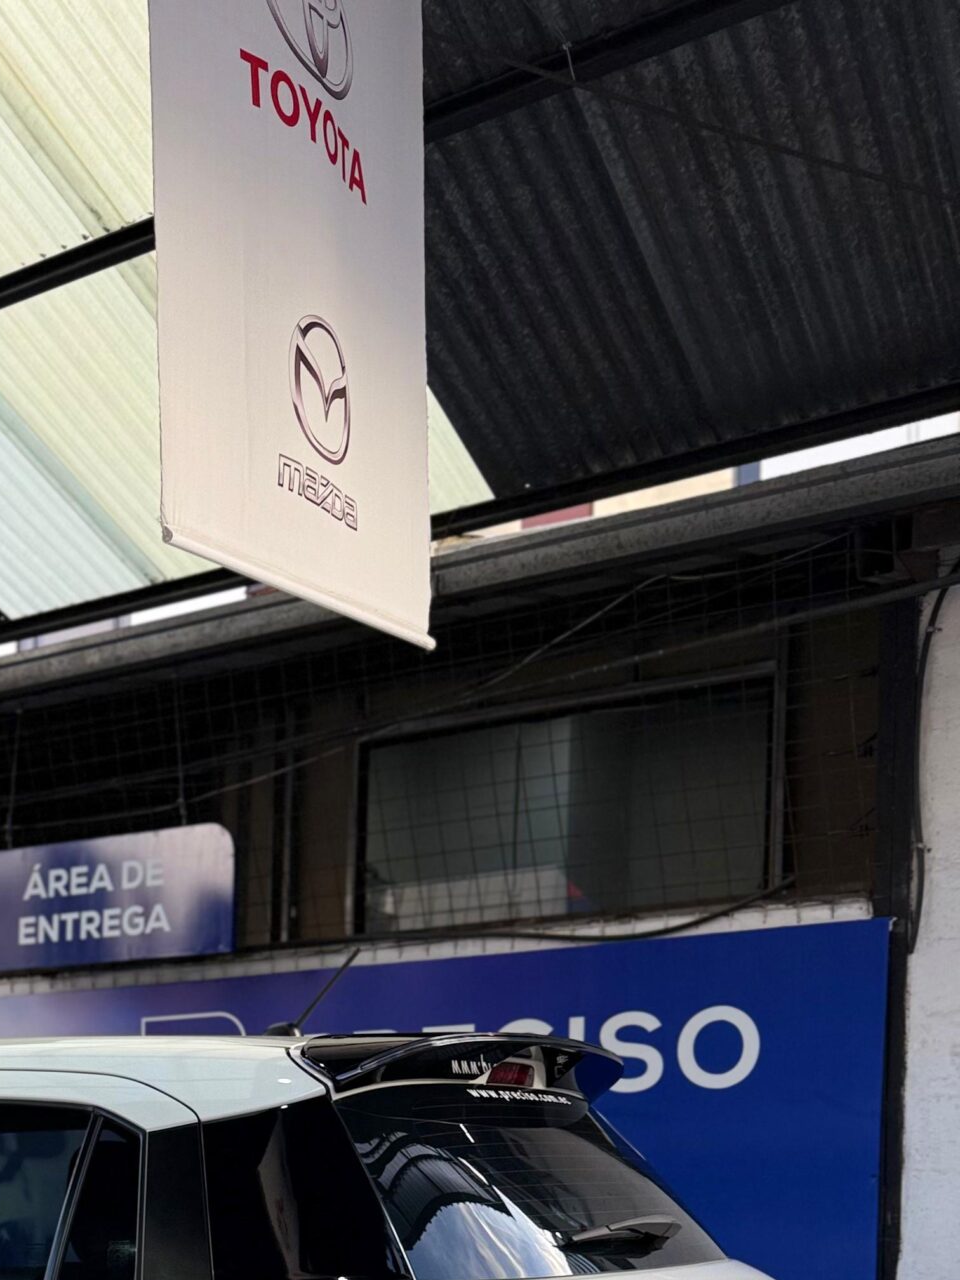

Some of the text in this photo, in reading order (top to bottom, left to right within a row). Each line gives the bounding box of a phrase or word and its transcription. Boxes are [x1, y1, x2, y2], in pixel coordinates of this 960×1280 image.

[239, 47, 367, 205] TOYOTA
[22, 858, 165, 900] ÁREA DE
[17, 904, 171, 946] ENTREGA
